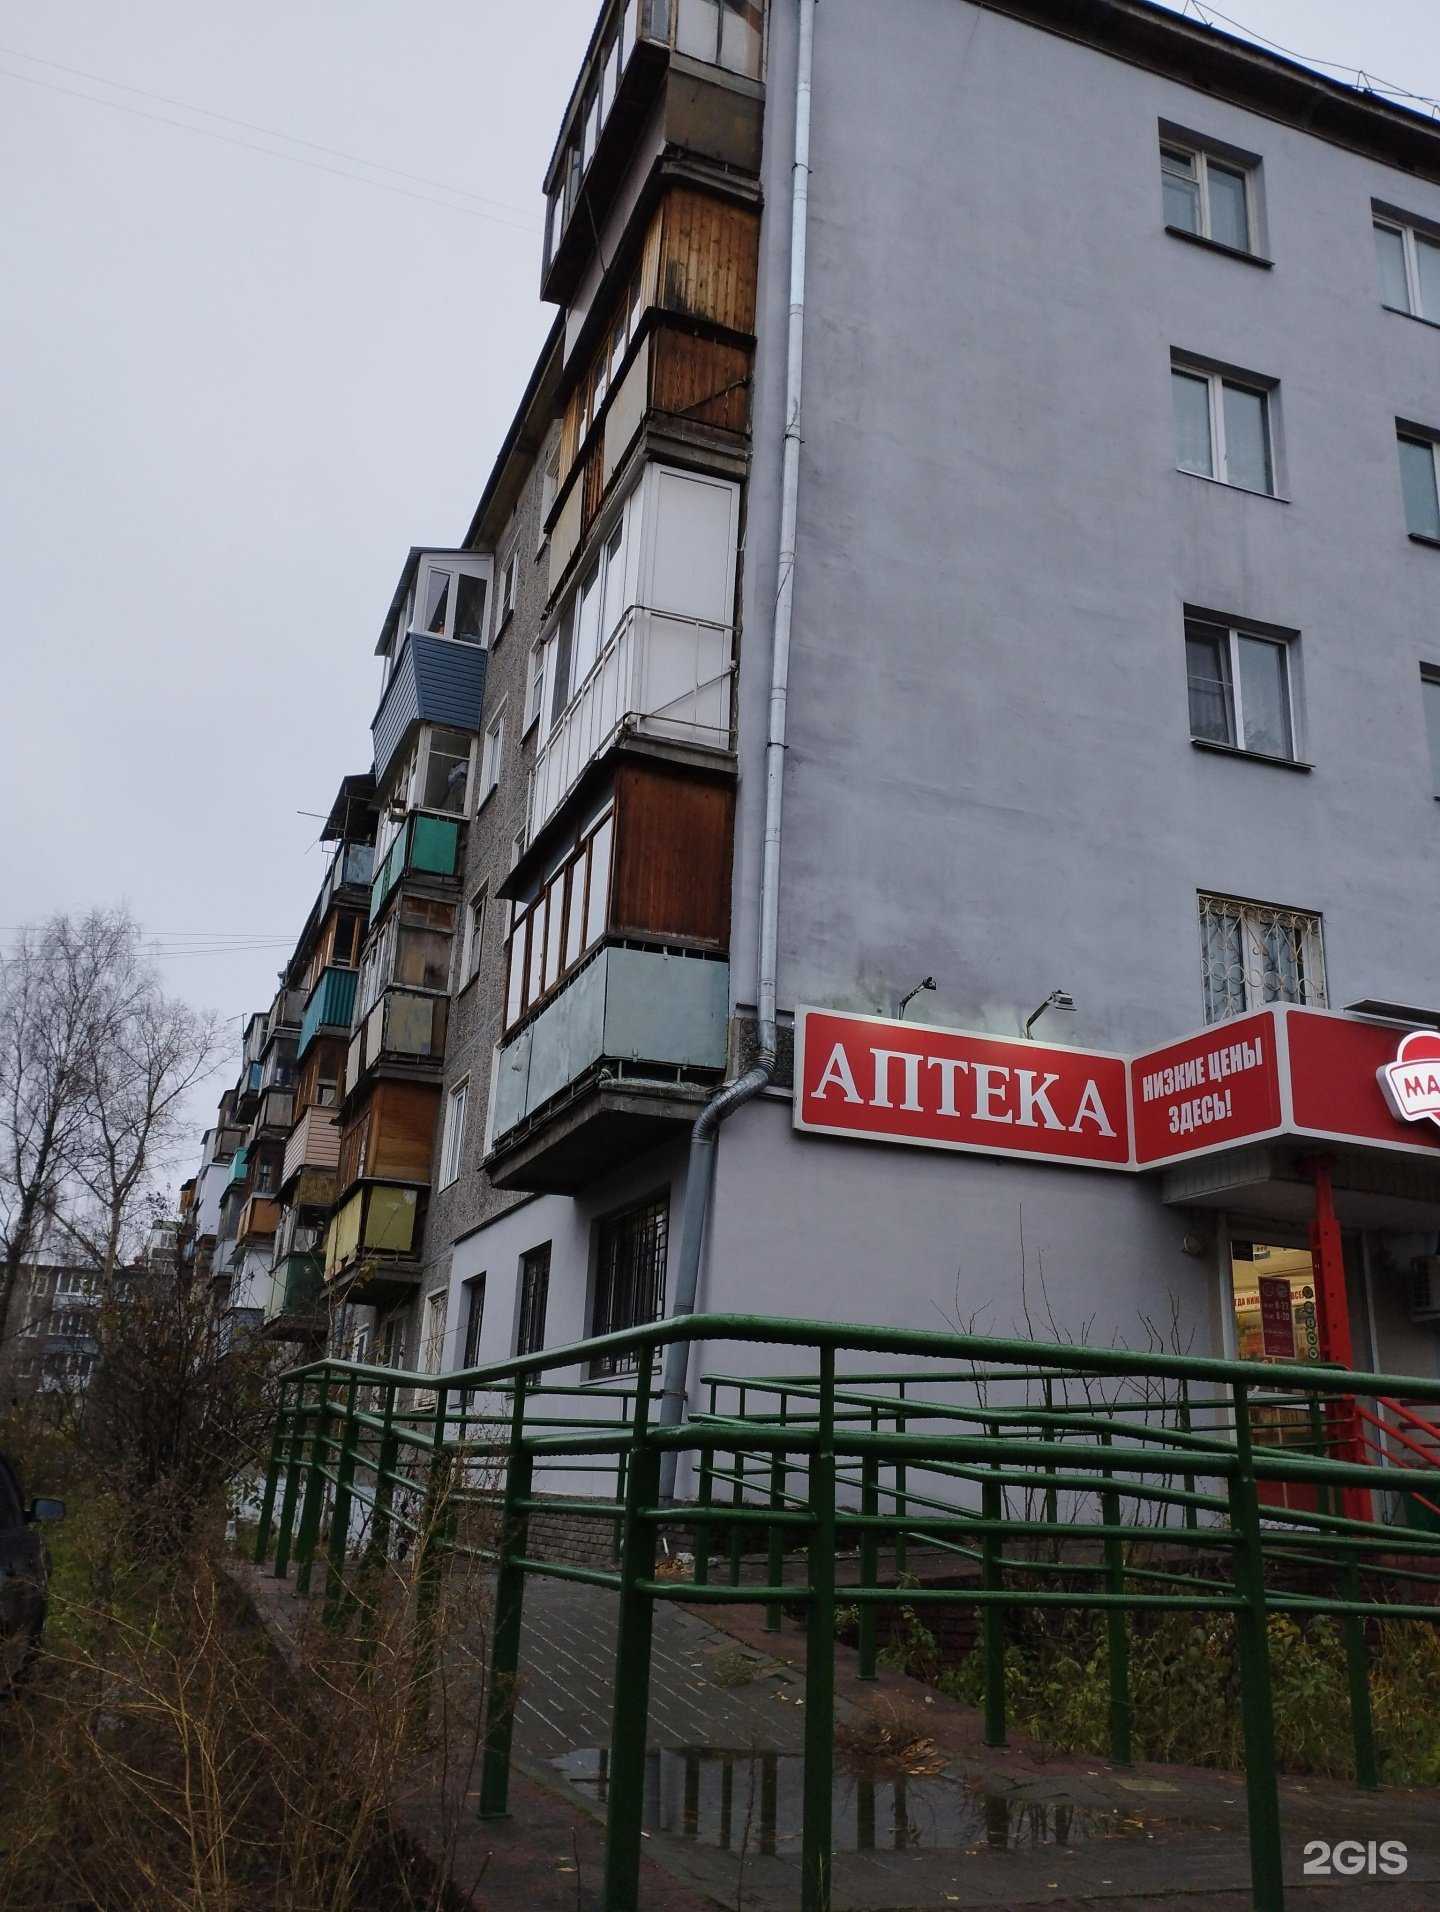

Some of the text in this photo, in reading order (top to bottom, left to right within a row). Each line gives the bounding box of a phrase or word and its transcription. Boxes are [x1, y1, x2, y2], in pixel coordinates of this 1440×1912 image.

[810, 1042, 1117, 1137] АПТЕКА
[1143, 1036, 1263, 1103] НИЗКИЕ ЦЕНЫ
[1168, 1088, 1233, 1136] ЗДЕСЬ!
